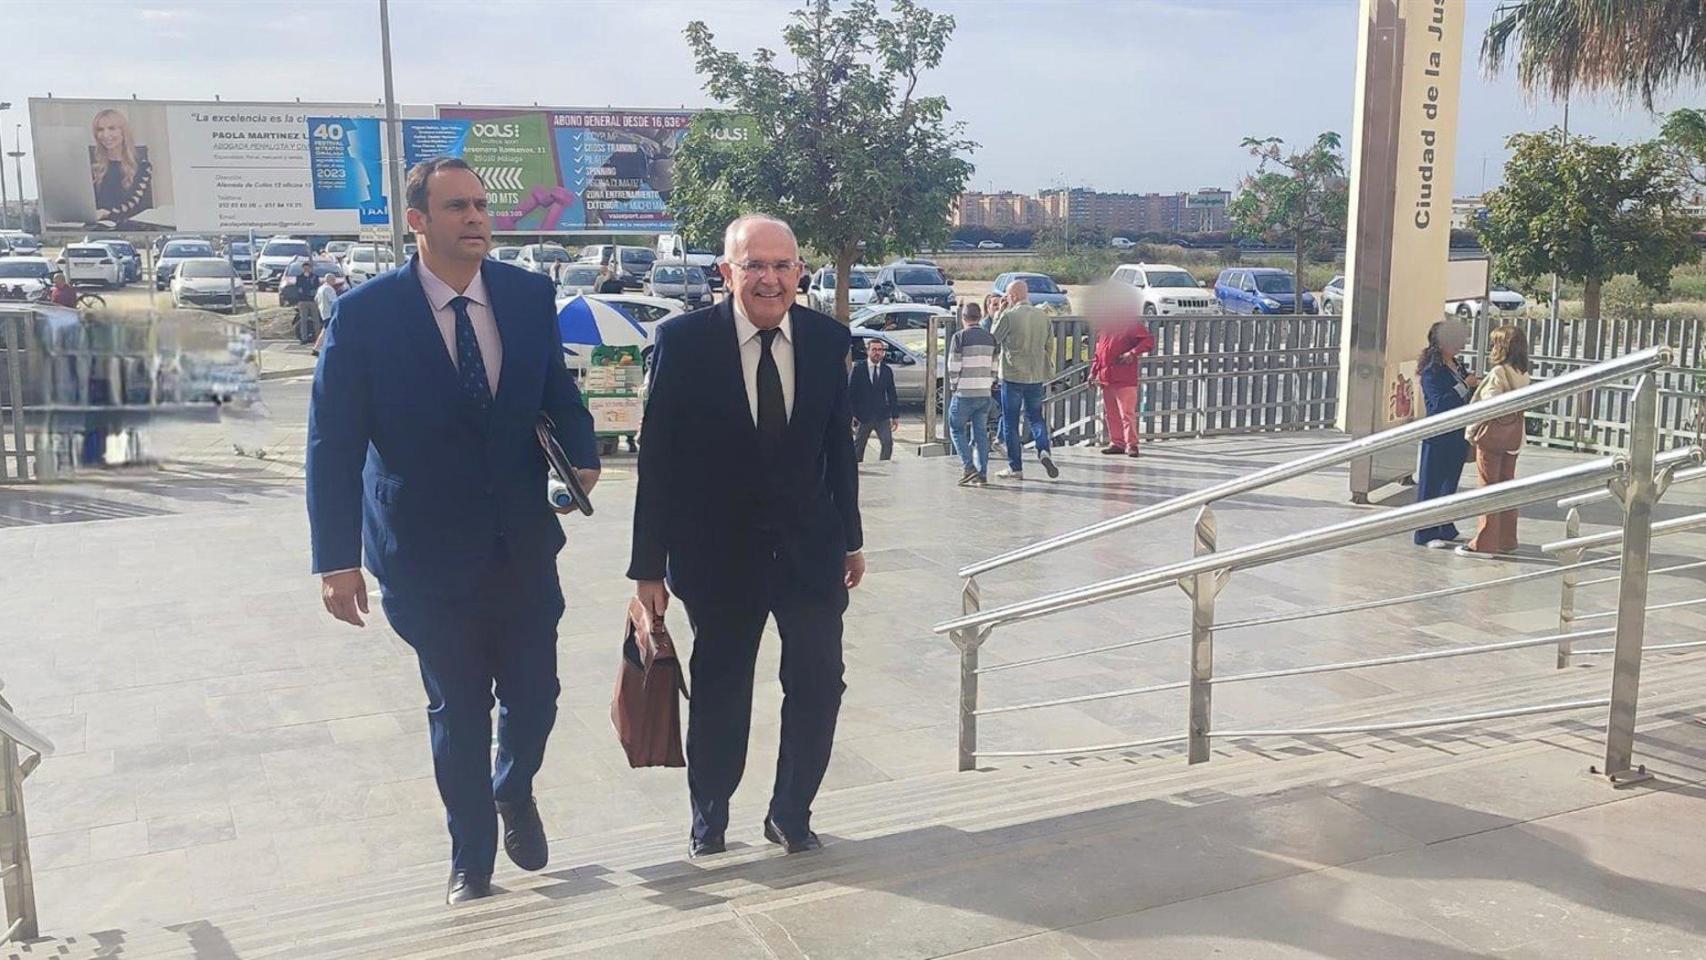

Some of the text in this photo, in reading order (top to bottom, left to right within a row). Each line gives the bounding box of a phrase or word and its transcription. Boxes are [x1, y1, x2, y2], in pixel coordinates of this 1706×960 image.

[1425, 52, 1441, 77] la
[1423, 86, 1438, 120] de
[212, 113, 267, 123] excelencia
[270, 115, 282, 123] es
[285, 113, 295, 123] la
[553, 115, 581, 127] ABONO
[584, 115, 620, 127] GENERAL
[623, 116, 649, 127] DESDE
[313, 123, 344, 141] 40
[585, 143, 606, 153] CROSS
[316, 168, 346, 178] 2023
[586, 167, 617, 176] SPINNING
[1415, 130, 1436, 229] Ciudad
[500, 192, 519, 204] MTS
[586, 190, 603, 199] ZONA
